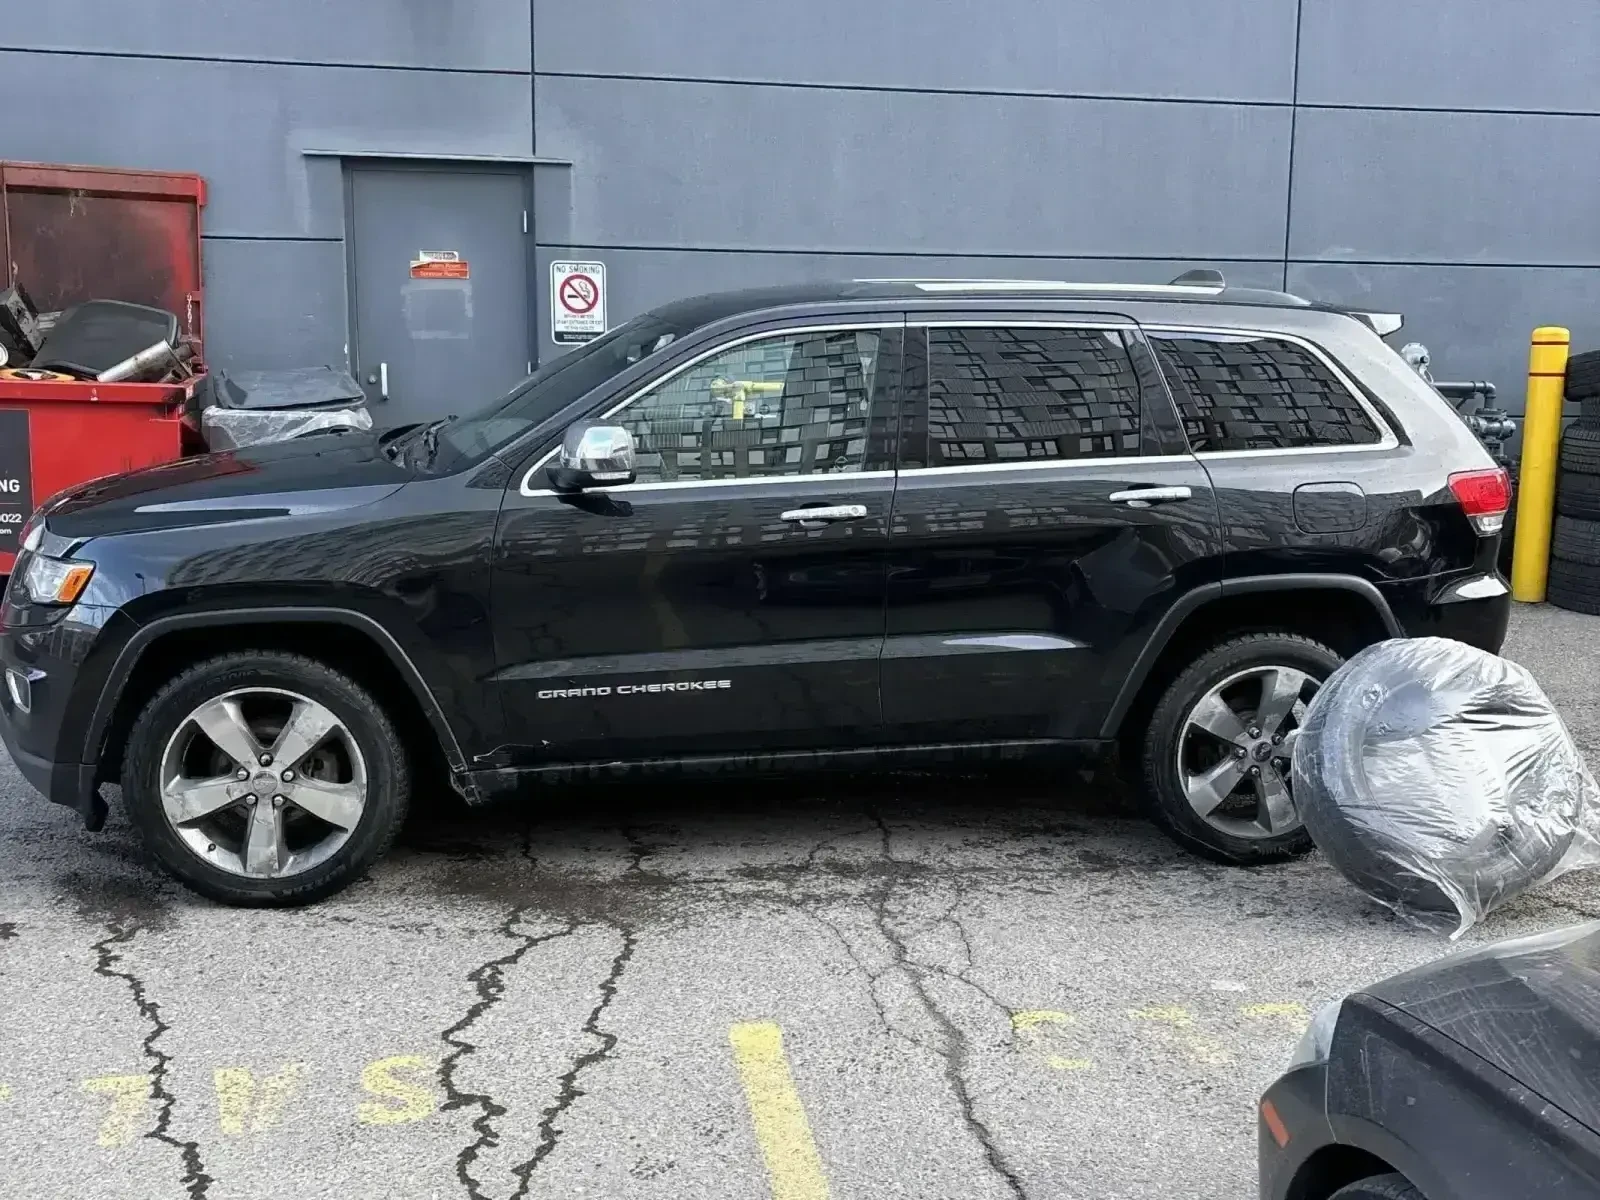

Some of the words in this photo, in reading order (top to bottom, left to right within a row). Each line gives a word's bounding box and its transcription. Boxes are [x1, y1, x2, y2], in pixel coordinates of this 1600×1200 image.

[556, 265, 566, 273] NO
[568, 265, 601, 274] SMOKING
[537, 686, 611, 699] GRAND
[616, 679, 732, 694] CHEROKEE
